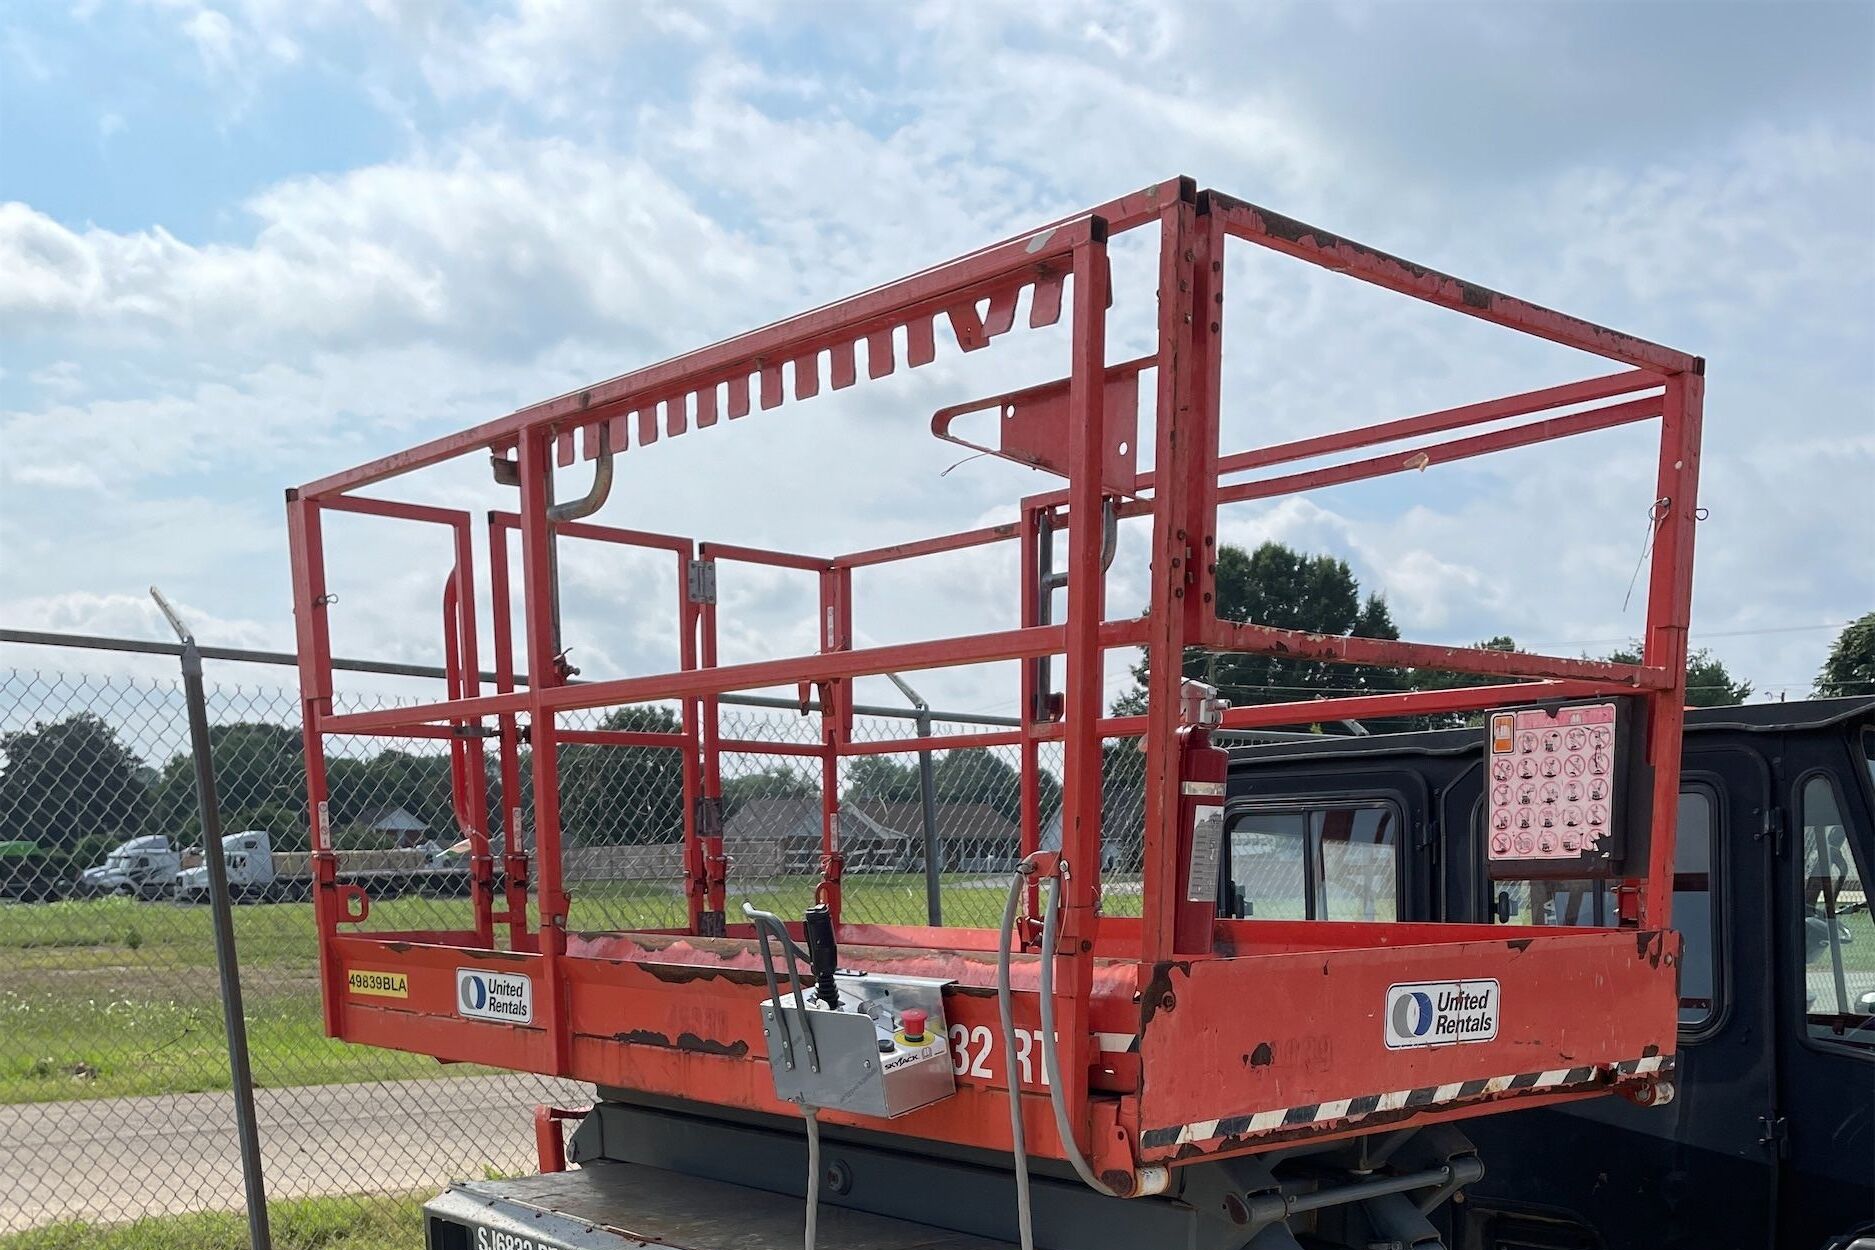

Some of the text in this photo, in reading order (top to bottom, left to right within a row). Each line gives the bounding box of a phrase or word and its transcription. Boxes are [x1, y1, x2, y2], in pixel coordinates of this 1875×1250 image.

[348, 974, 407, 993] 49839BLA
[488, 979, 524, 998] United
[489, 997, 528, 1016] Rentals
[1437, 989, 1490, 1012] United
[1435, 1012, 1492, 1035] Rentals
[884, 1052, 919, 1071] SKYJACK
[1014, 1028, 1059, 1086] RT
